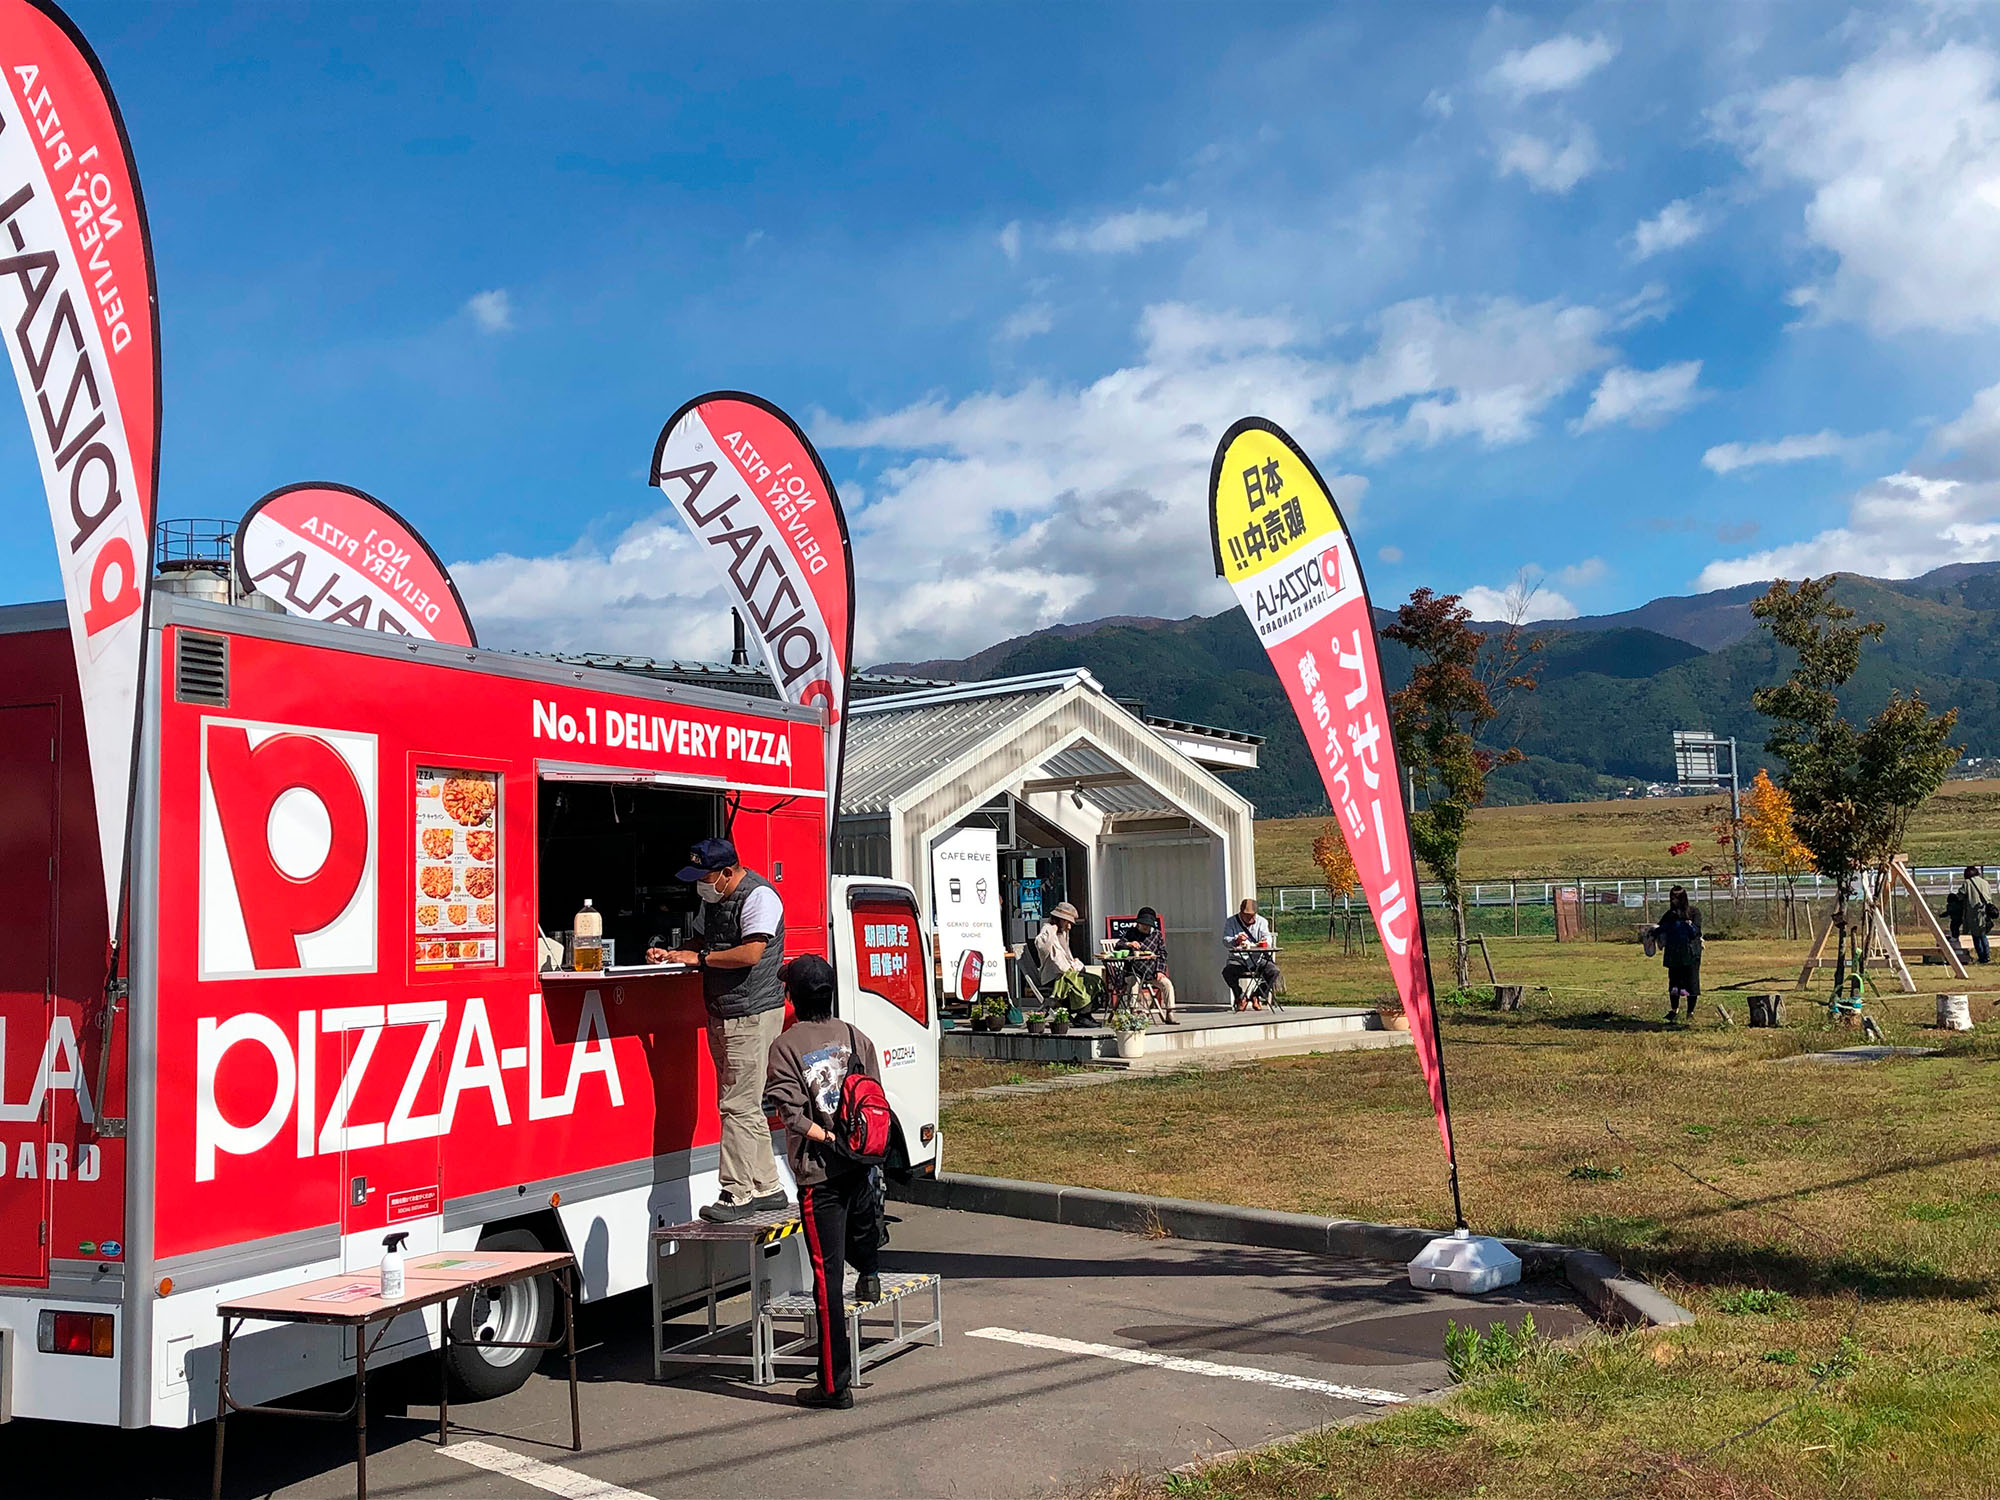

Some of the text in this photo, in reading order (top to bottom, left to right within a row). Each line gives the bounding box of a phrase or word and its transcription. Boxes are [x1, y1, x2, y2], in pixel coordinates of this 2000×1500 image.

[533, 699, 792, 767] No.1 DELIVERY PIZZA
[864, 924, 909, 948] 期間限定
